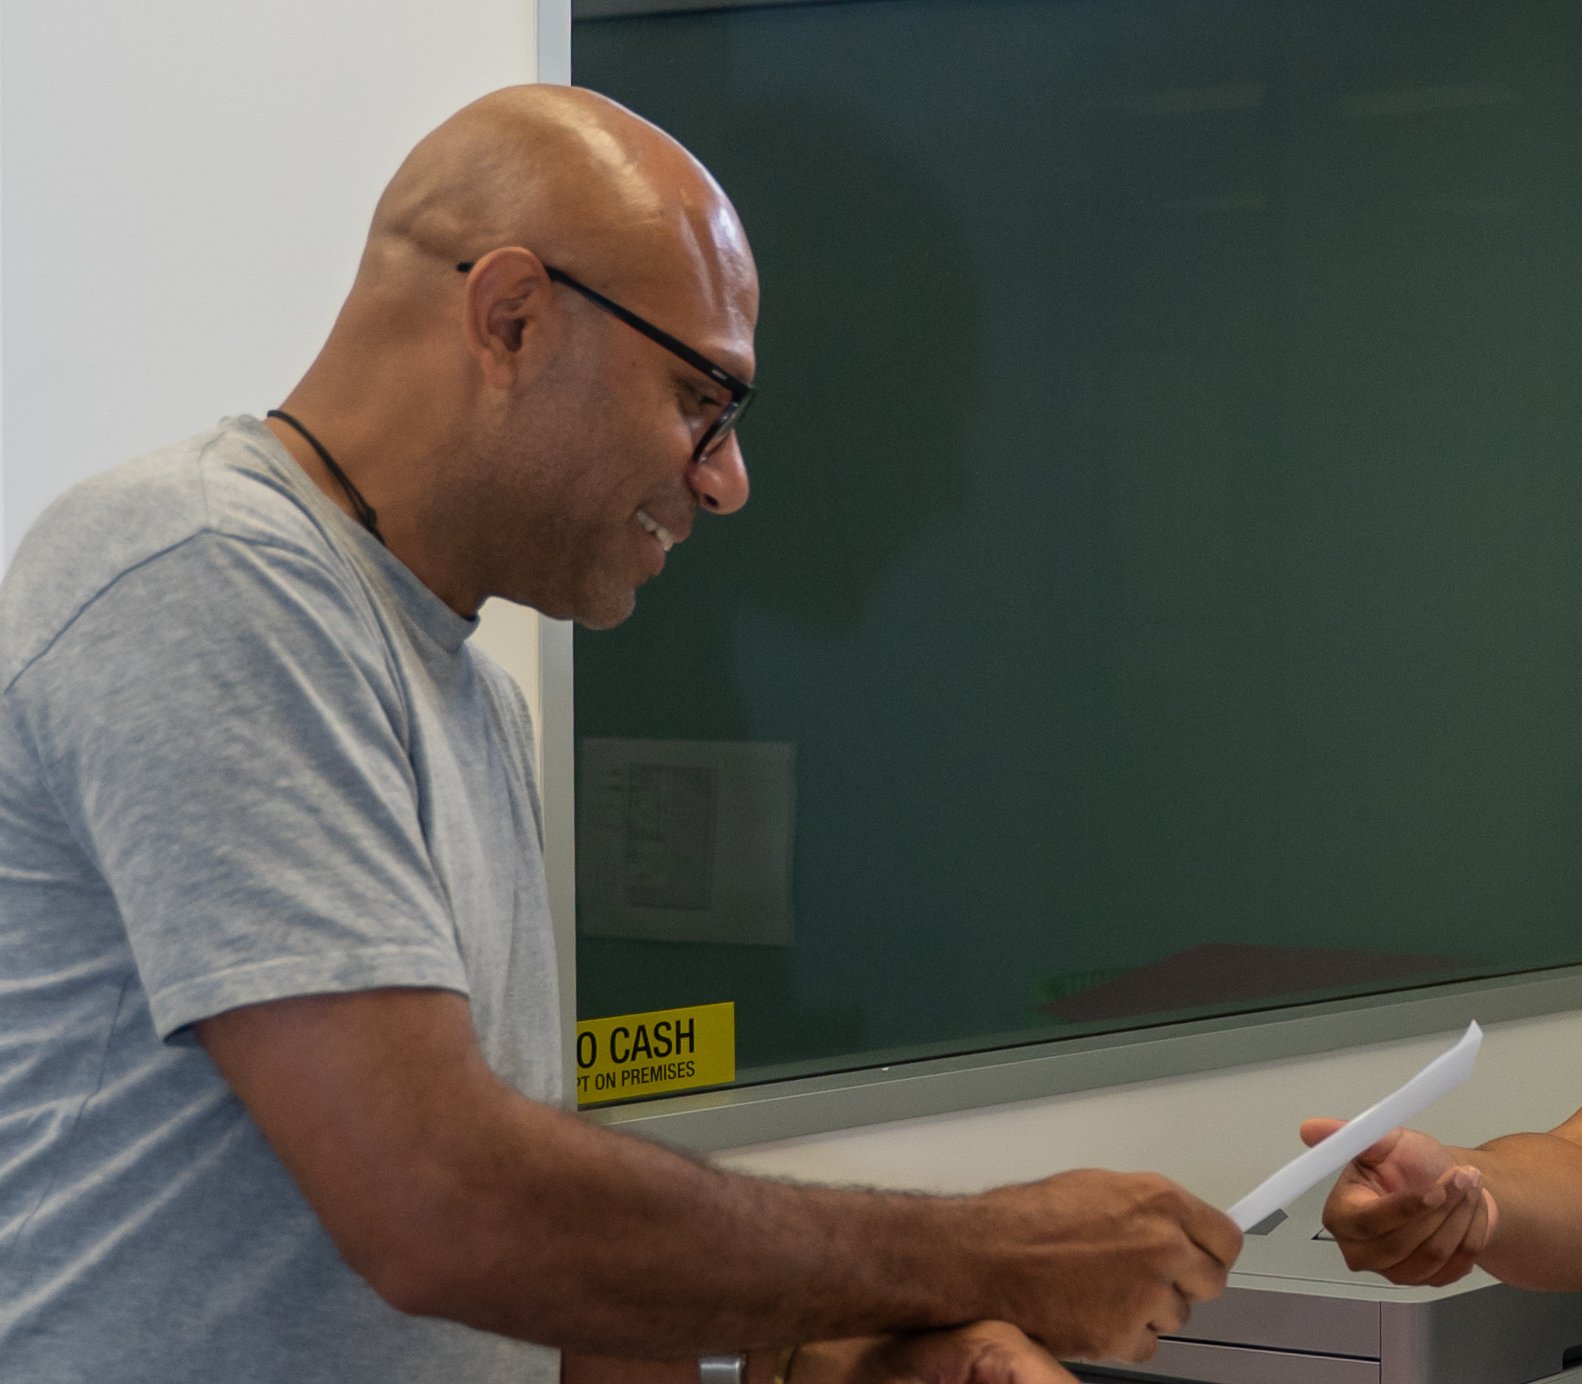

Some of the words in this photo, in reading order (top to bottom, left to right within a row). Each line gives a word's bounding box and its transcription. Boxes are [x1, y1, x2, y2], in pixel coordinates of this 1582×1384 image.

[610, 1018, 694, 1064] CASH
[595, 1072, 616, 1090] ON
[622, 1061, 695, 1086] PREMISES
